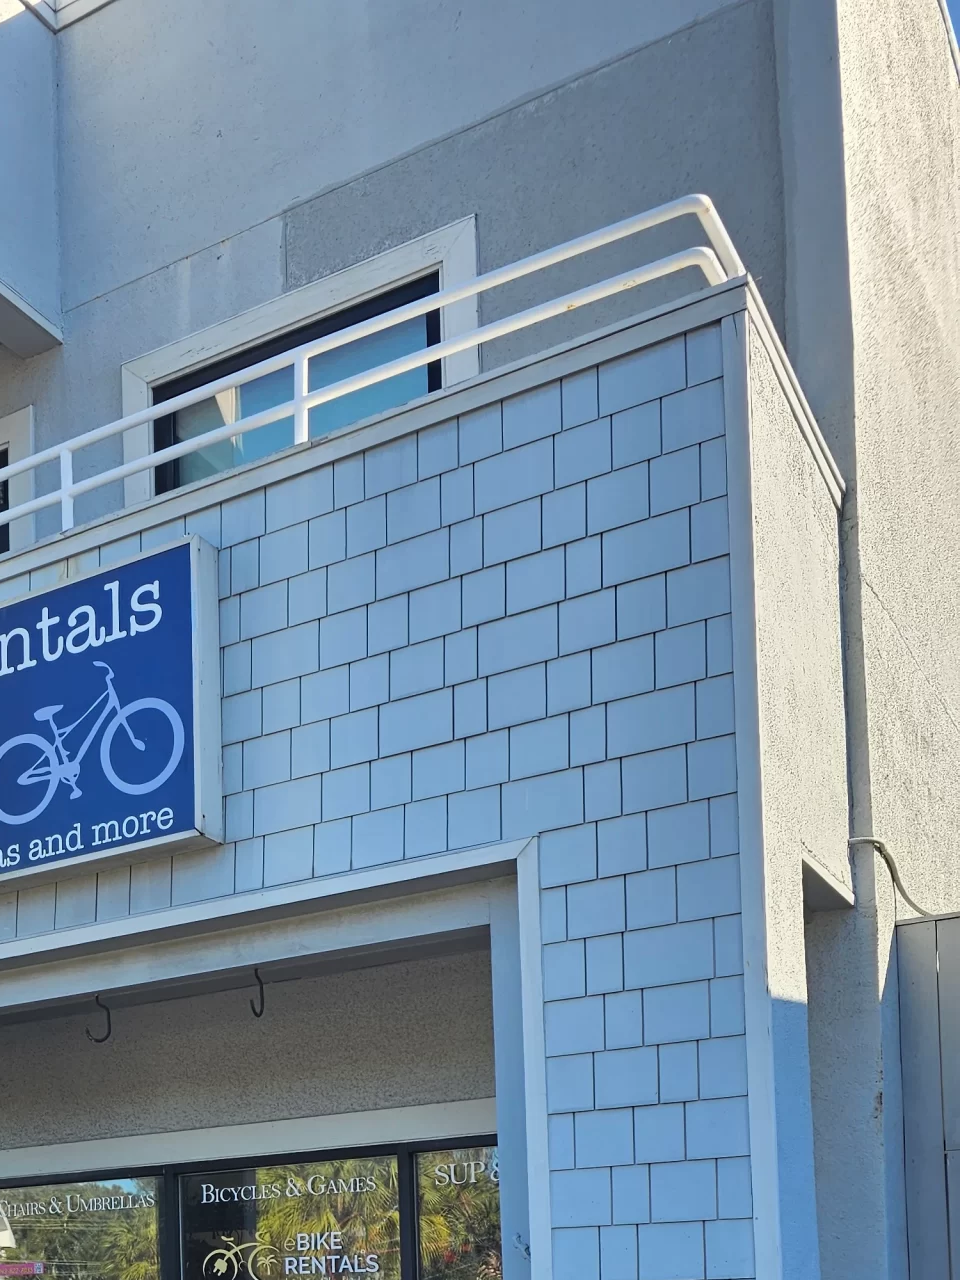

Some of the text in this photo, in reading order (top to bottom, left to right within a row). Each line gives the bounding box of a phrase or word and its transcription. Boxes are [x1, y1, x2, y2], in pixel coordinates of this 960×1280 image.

[28, 824, 84, 862] and
[92, 805, 175, 844] more
[434, 1161, 486, 1187] SUP
[200, 1174, 377, 1204] BICYCLES & GAMES
[48, 1196, 62, 1214] &
[66, 1193, 155, 1212] UMBRELLAS
[283, 1231, 343, 1252] eBIKE
[284, 1253, 380, 1275] RENTALS
